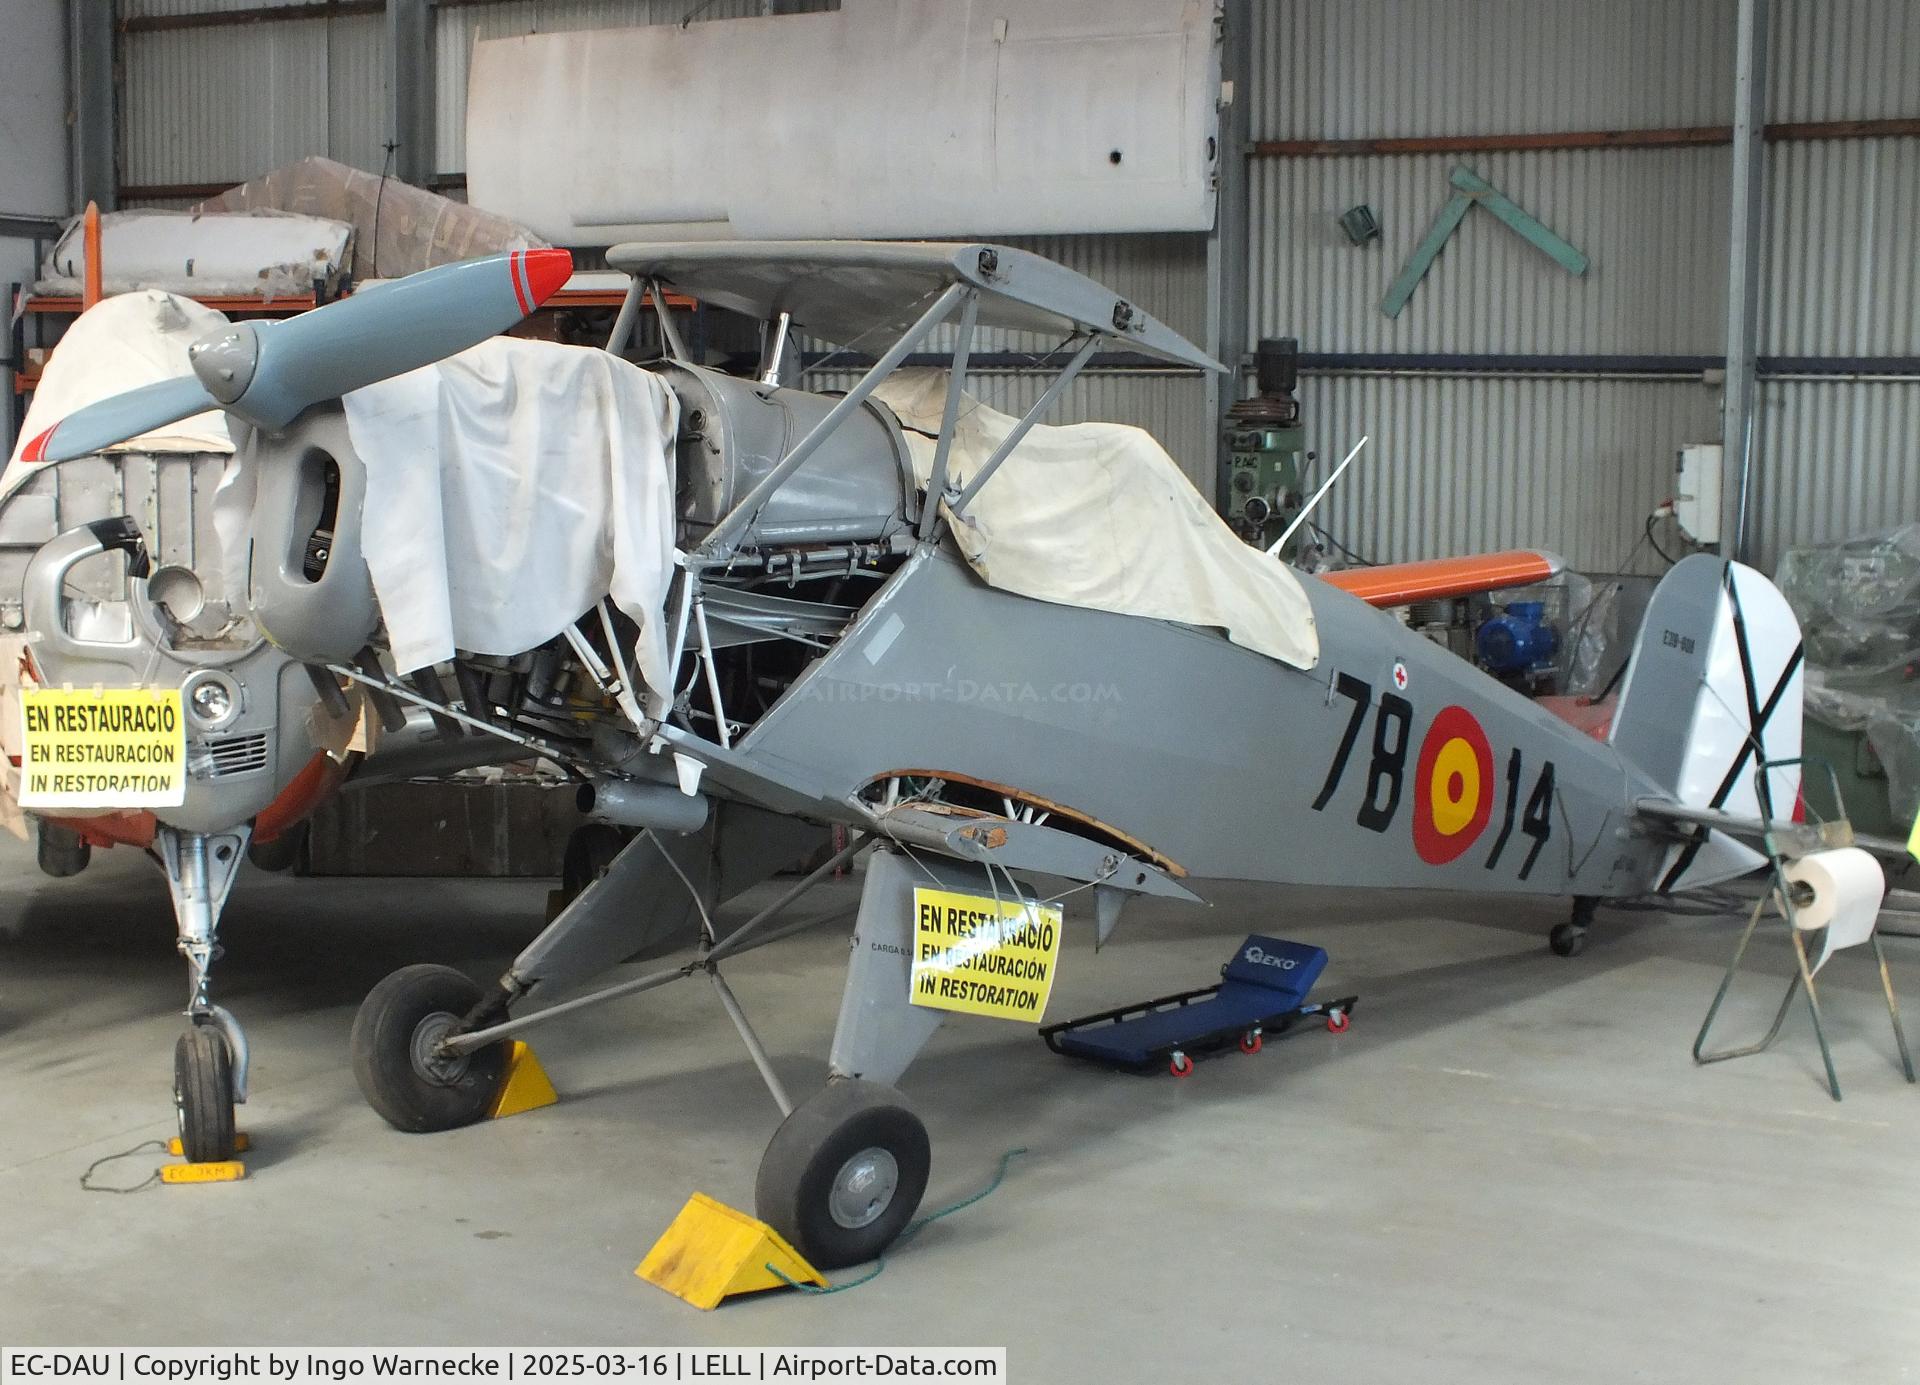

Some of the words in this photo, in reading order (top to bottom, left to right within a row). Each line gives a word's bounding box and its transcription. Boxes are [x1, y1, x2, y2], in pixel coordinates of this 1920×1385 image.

[26, 705, 49, 732] EN
[55, 698, 175, 733] RESTAURACIÓ
[31, 744, 50, 762] EN
[56, 739, 174, 763] RESTAURACIÓN
[31, 774, 47, 792] IN
[53, 774, 171, 792] RESTORATION
[1312, 672, 1413, 833] 78
[1485, 747, 1555, 880] 14
[920, 904, 942, 934] EN
[871, 942, 899, 954] CARGA
[922, 943, 941, 963] EN
[1244, 945, 1296, 970] GEKO
[920, 975, 937, 995] IN
[940, 977, 1039, 1010] RESTORATION
